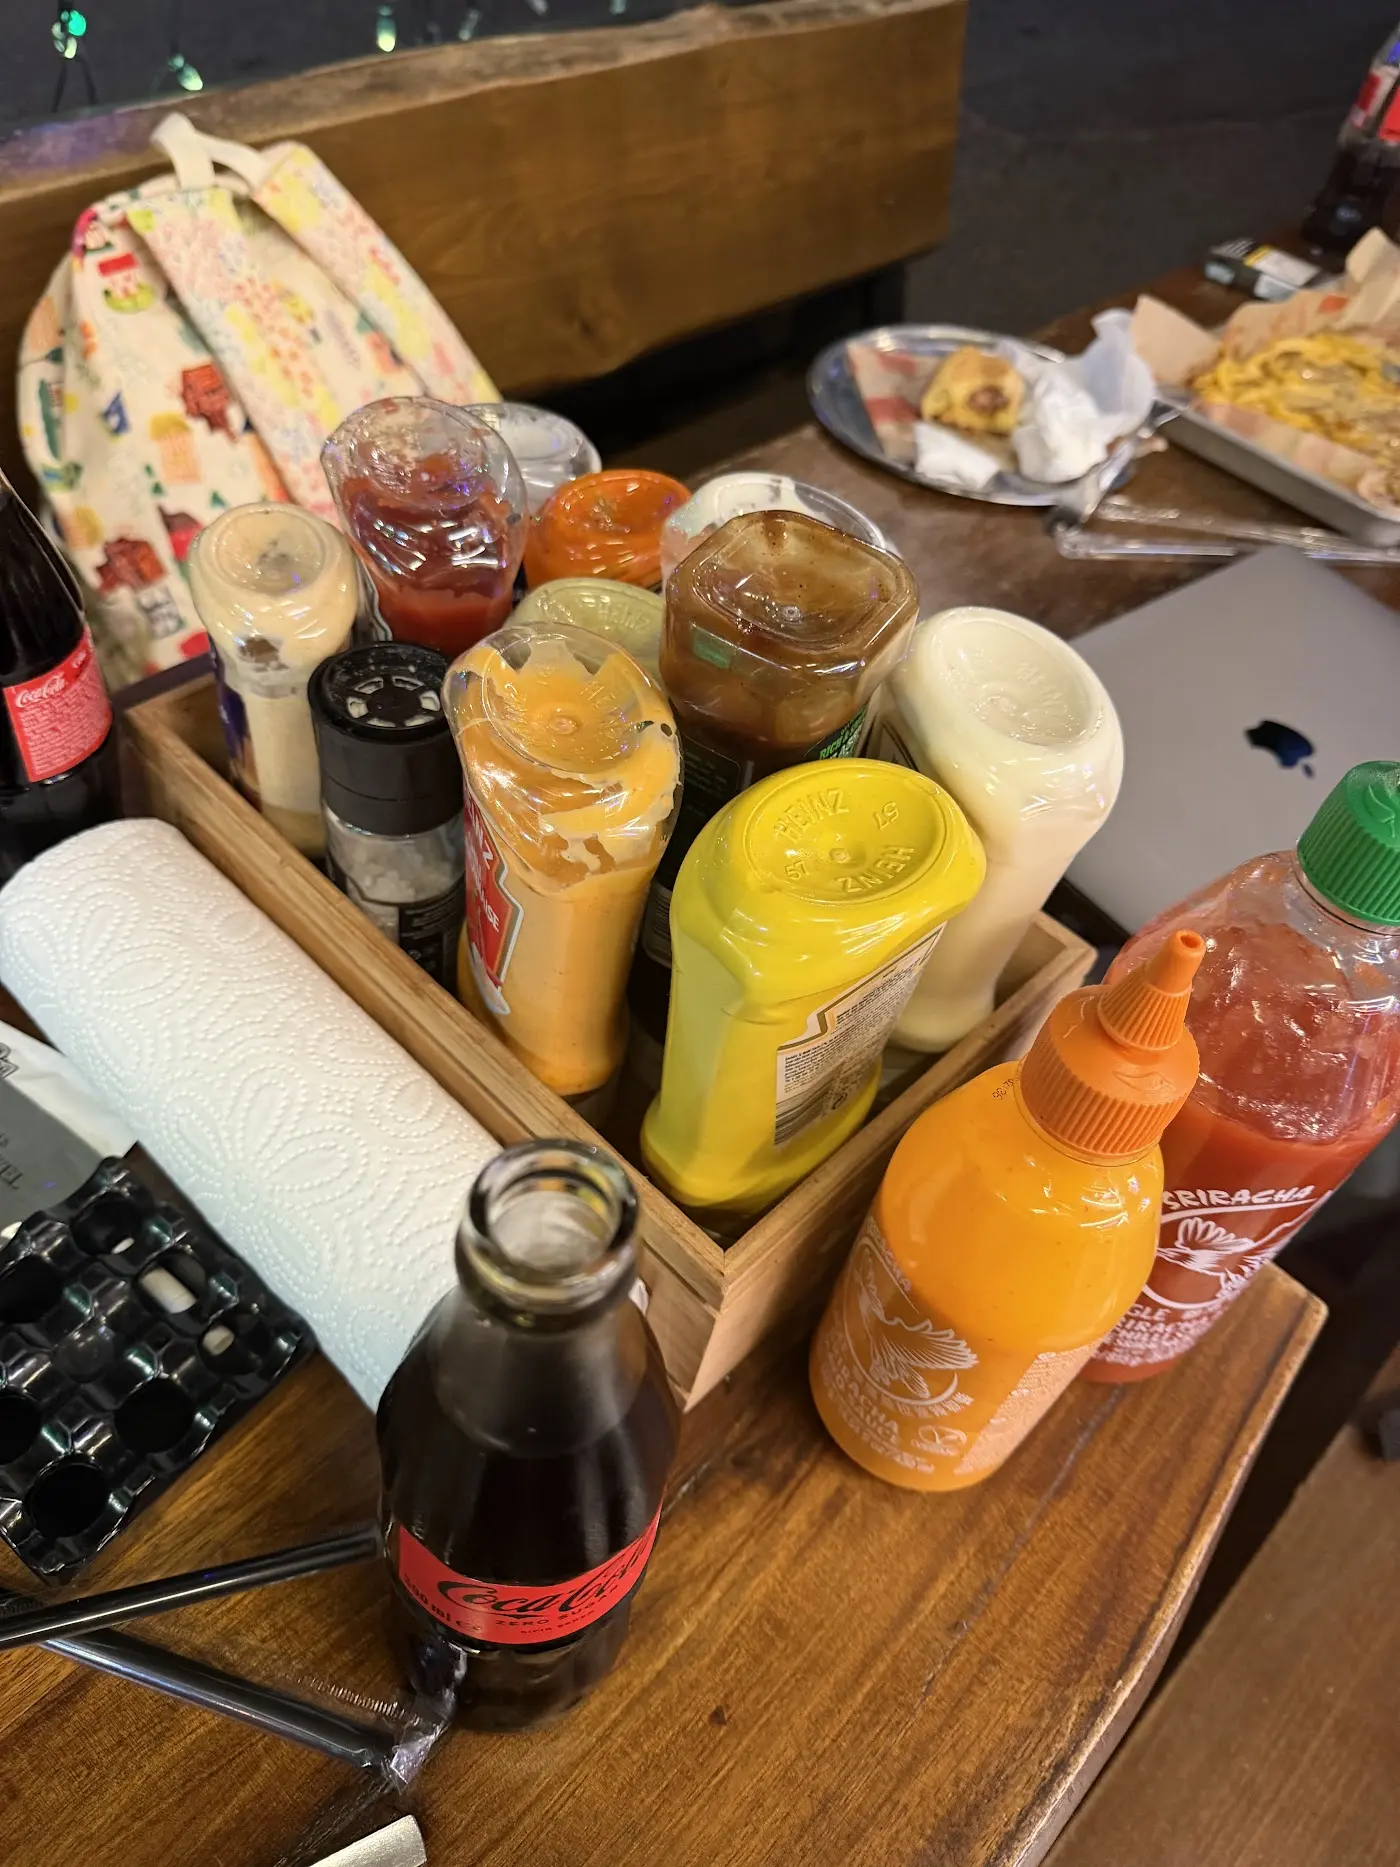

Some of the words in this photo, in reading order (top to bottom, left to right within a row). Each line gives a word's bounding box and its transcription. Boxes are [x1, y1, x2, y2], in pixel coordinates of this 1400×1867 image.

[774, 788, 849, 844] HEINZ
[873, 801, 899, 831] 57
[784, 860, 810, 881] 57
[836, 844, 915, 893] HEINZ
[1162, 1184, 1315, 1211] SRIRACHA
[495, 1619, 550, 1627] ZERO
